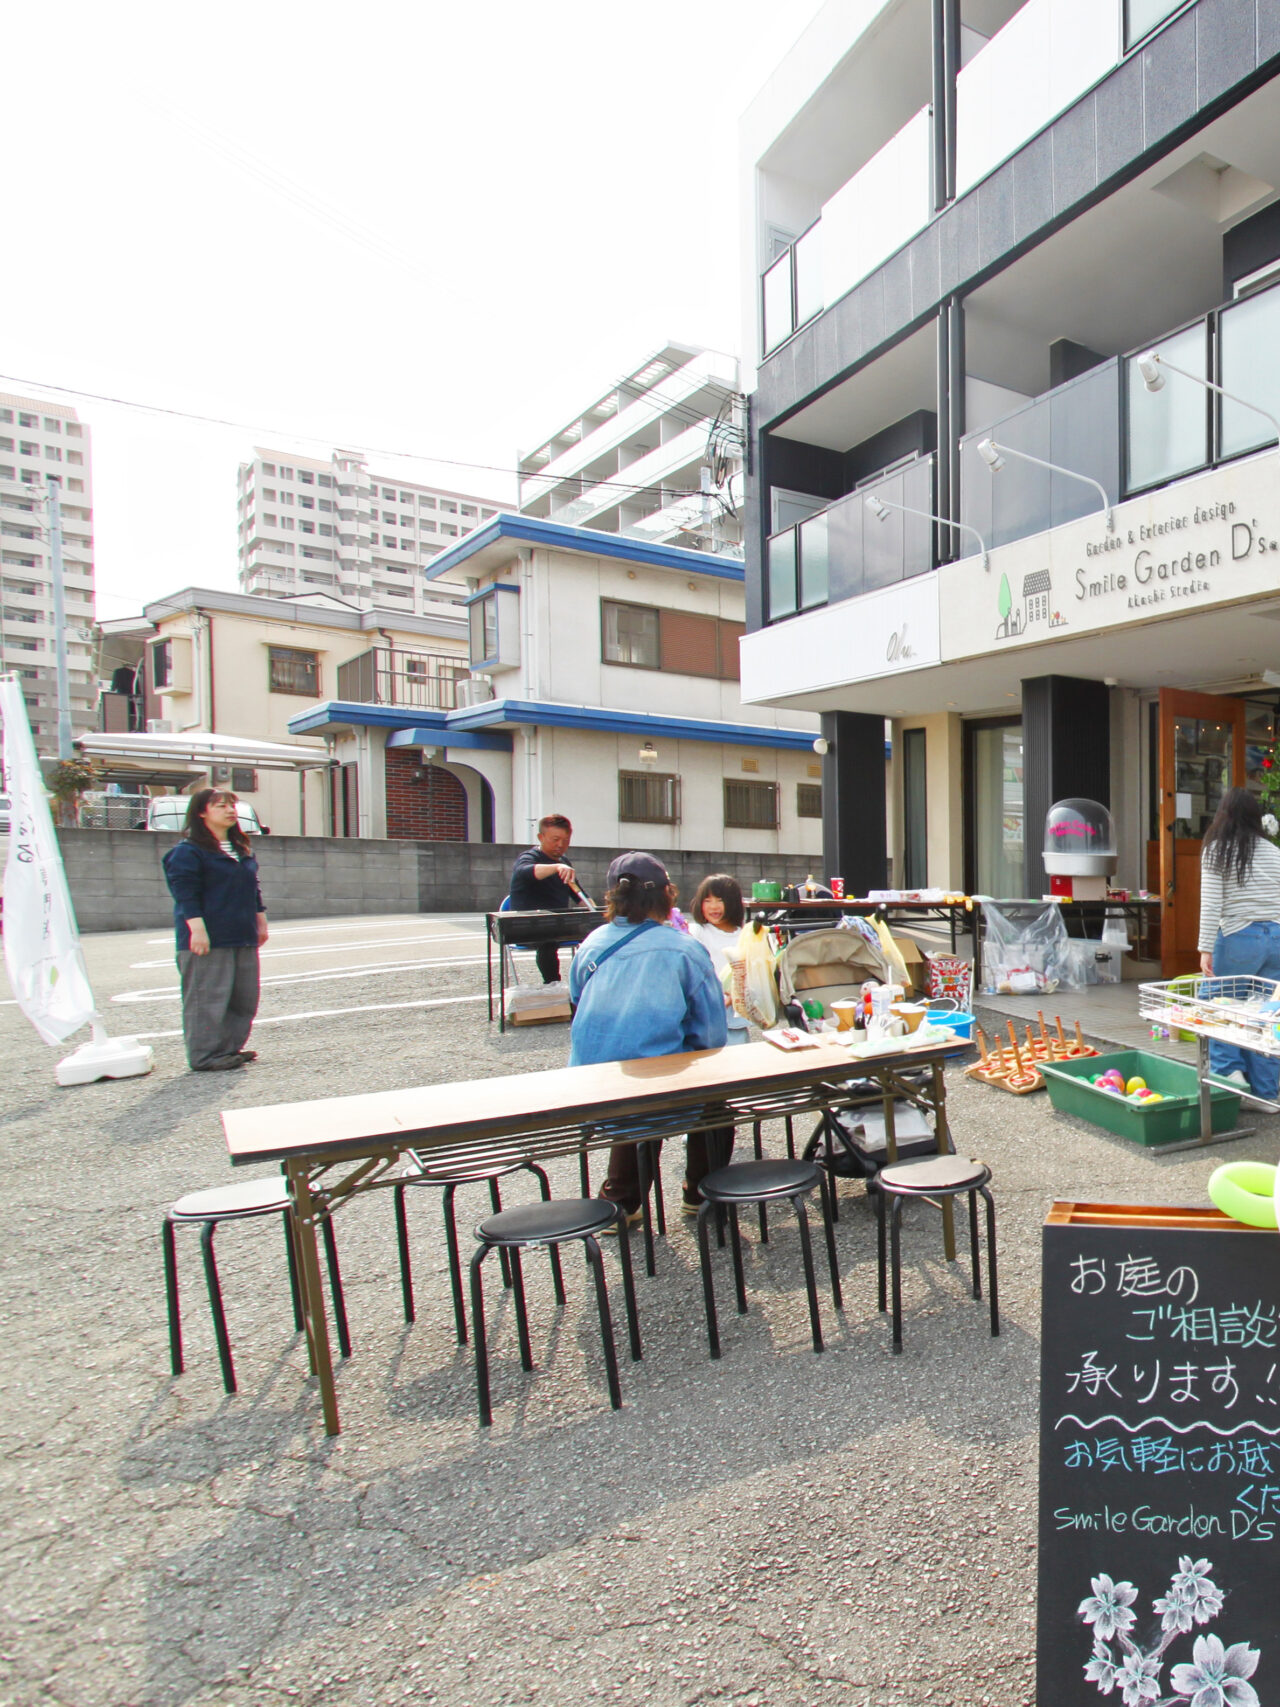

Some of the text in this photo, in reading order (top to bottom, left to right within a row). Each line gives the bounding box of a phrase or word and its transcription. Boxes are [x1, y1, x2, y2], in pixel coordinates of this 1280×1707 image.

[1086, 501, 1236, 558] Garden & Exterior design
[1075, 568, 1127, 601] Smile
[1134, 549, 1221, 584] Garden
[1170, 579, 1211, 599] Studio
[1069, 1254, 1199, 1305] お庭の
[1126, 1299, 1278, 1348] ご相談
[1230, 1508, 1277, 1541] D's
